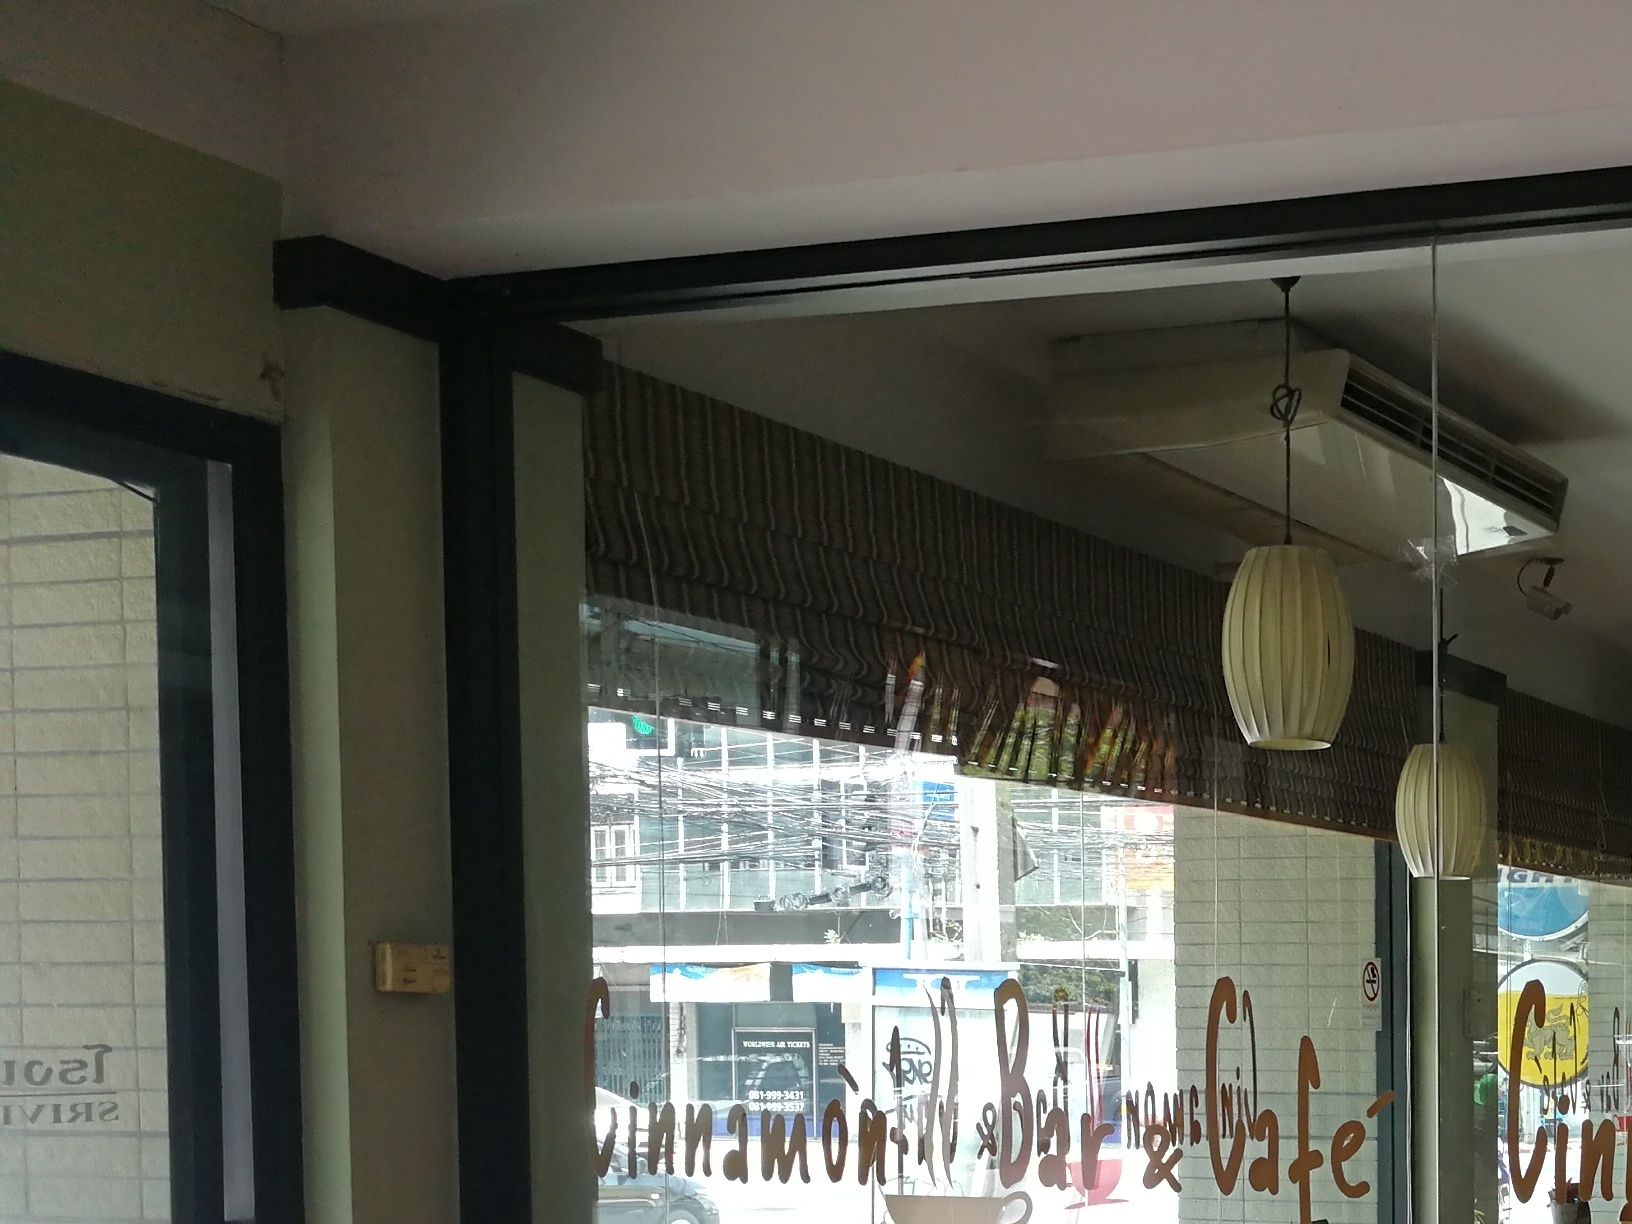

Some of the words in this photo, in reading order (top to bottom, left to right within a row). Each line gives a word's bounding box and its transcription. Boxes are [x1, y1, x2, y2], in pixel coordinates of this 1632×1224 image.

[584, 976, 887, 1186] Cinnamon
[993, 976, 1117, 1190] Bar
[1141, 1122, 1185, 1194] &
